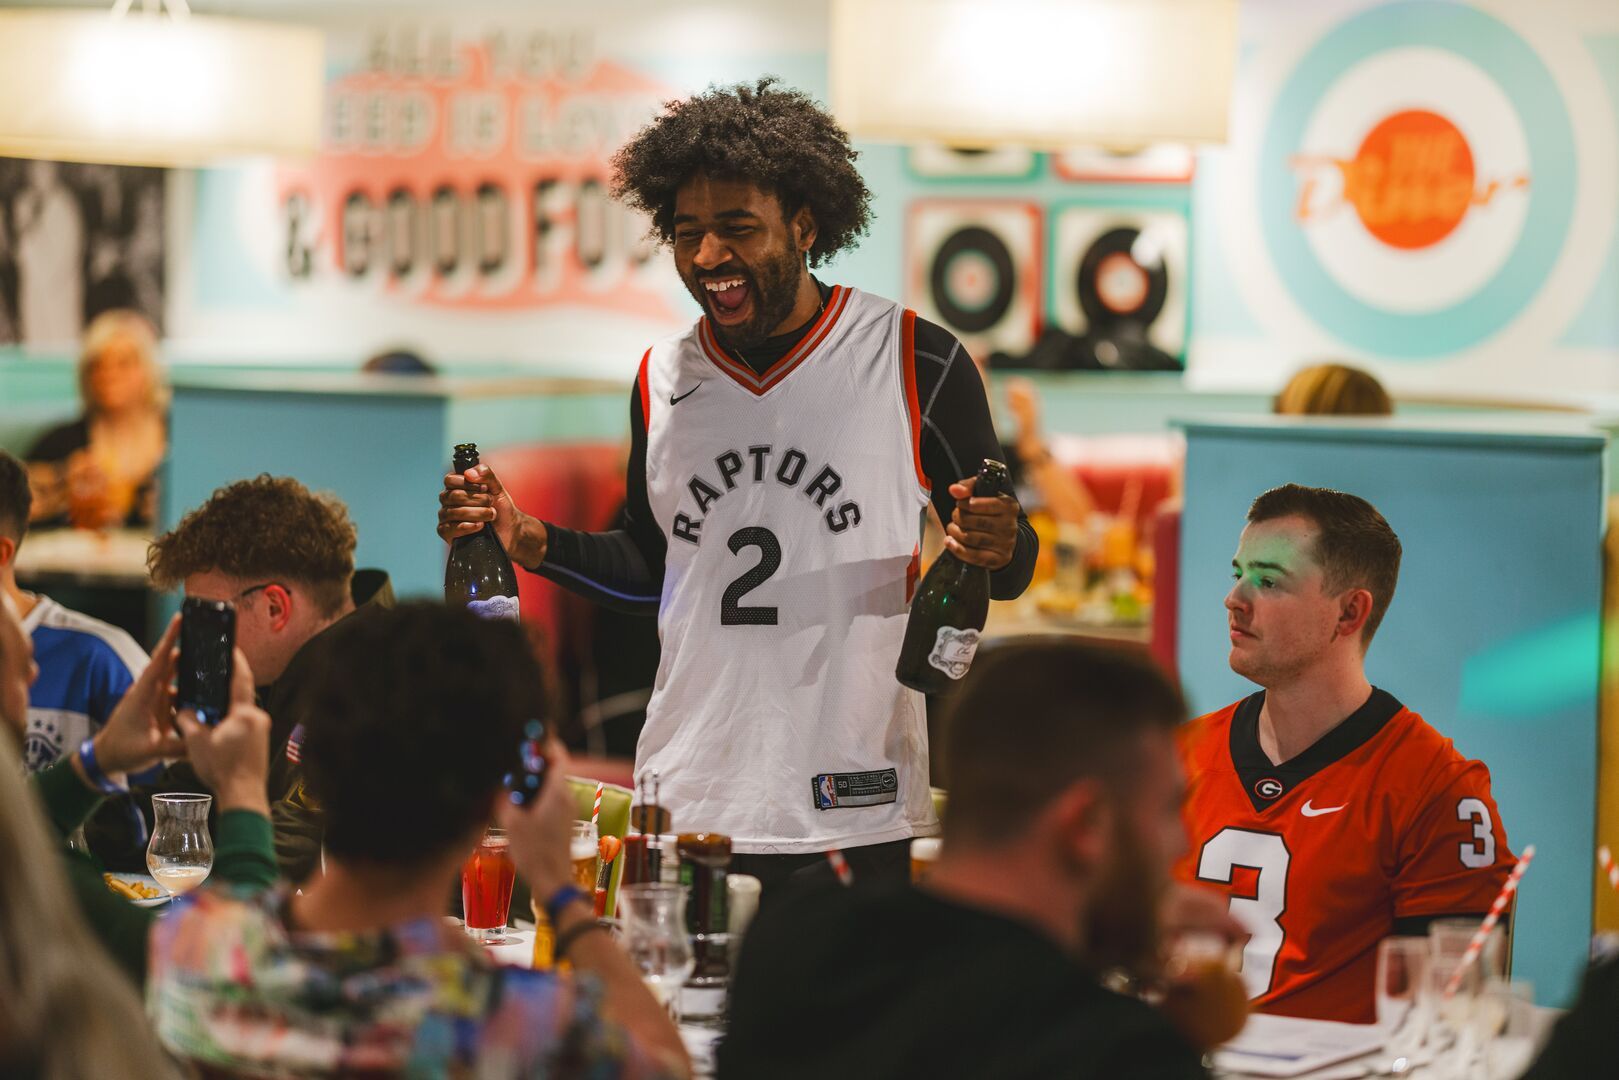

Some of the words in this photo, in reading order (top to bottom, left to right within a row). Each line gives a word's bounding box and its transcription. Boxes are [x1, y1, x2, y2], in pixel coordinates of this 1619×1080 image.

[672, 444, 861, 546] RAPTORS
[721, 526, 782, 625] 2
[1456, 797, 1496, 869] 3
[1196, 825, 1292, 1000] 3
